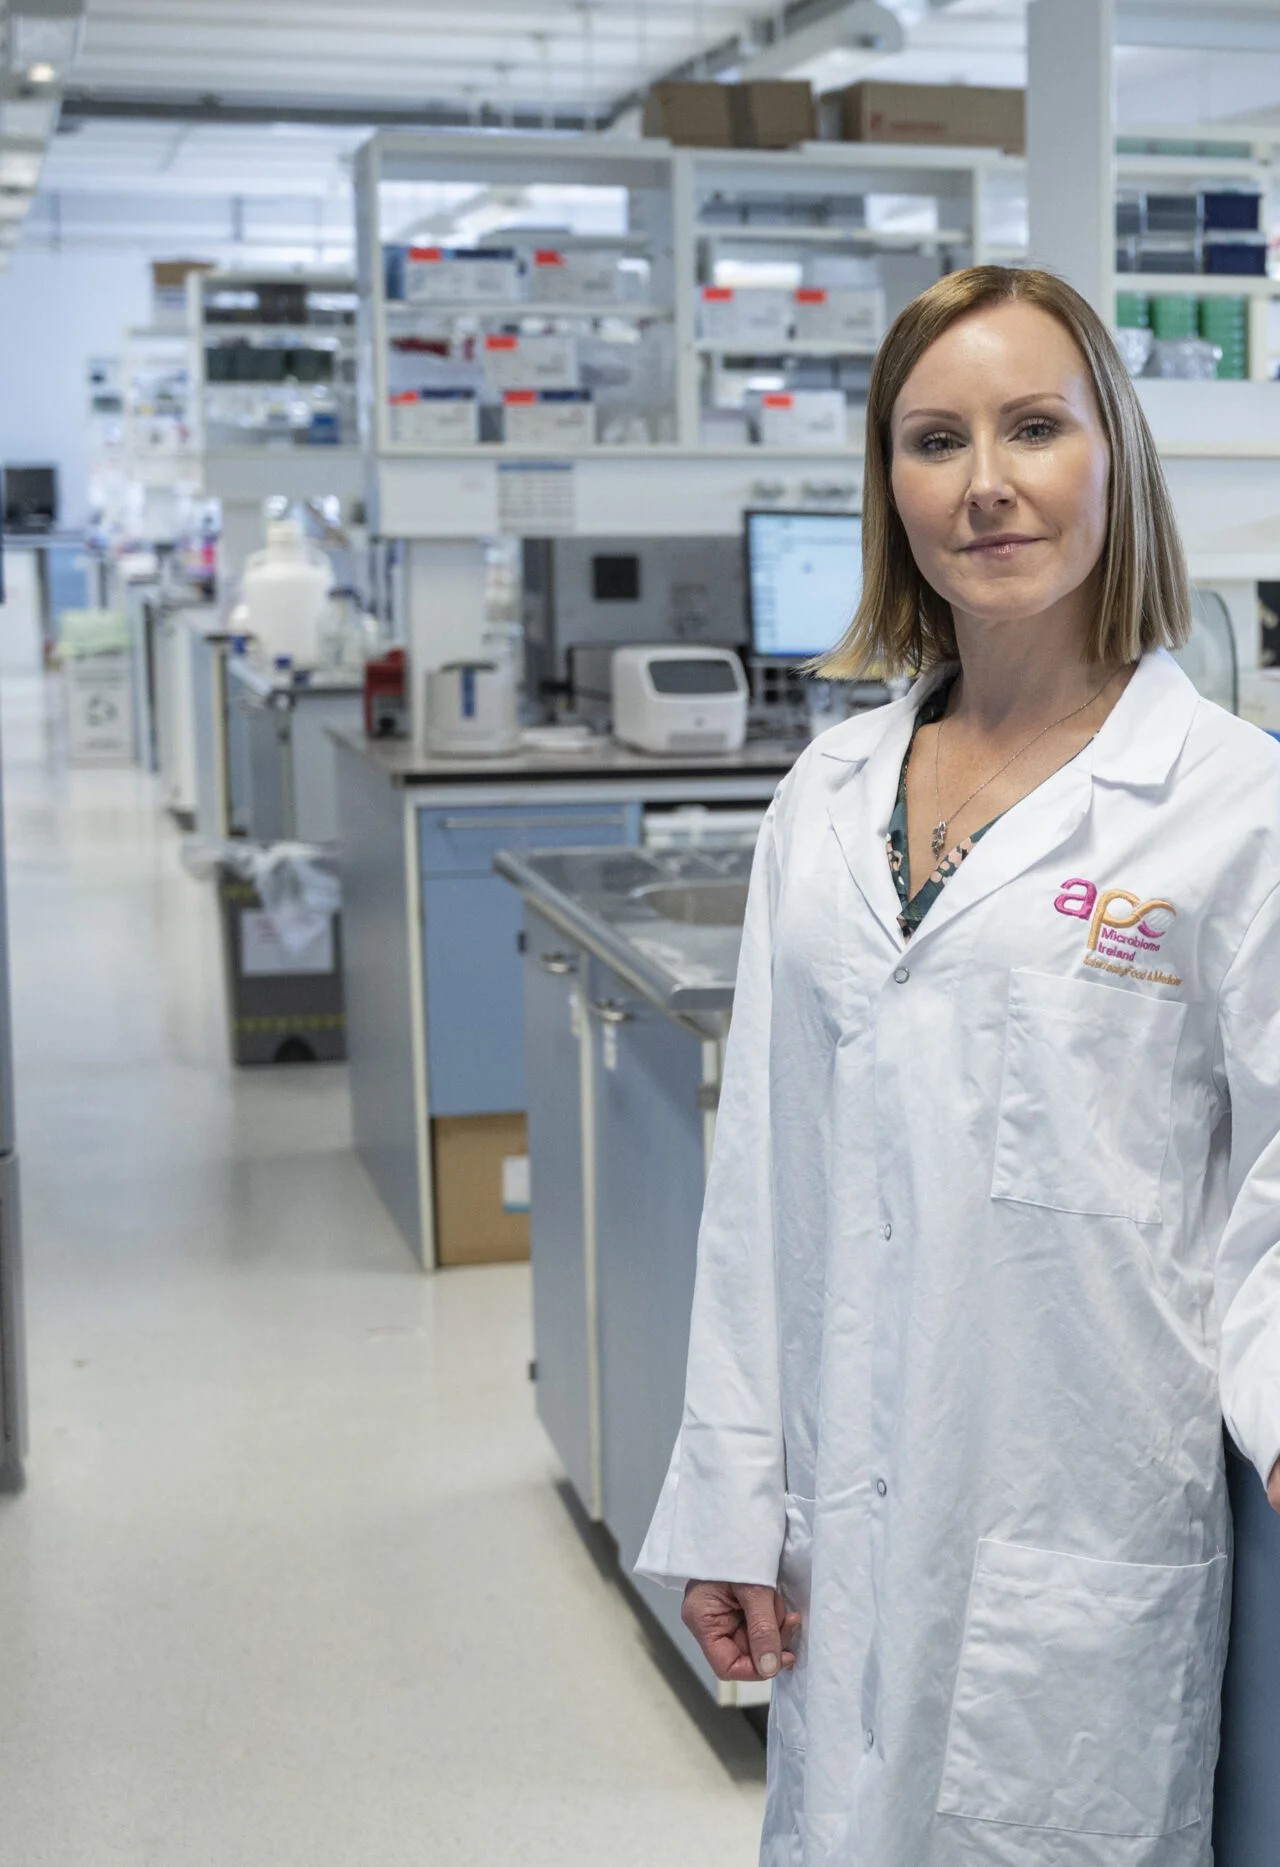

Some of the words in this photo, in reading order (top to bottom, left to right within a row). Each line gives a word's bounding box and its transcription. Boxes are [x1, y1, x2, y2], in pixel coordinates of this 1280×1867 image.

[1054, 878, 1177, 951] apc
[1097, 941, 1137, 962] Ireland
[1101, 927, 1161, 952] Microbiome
